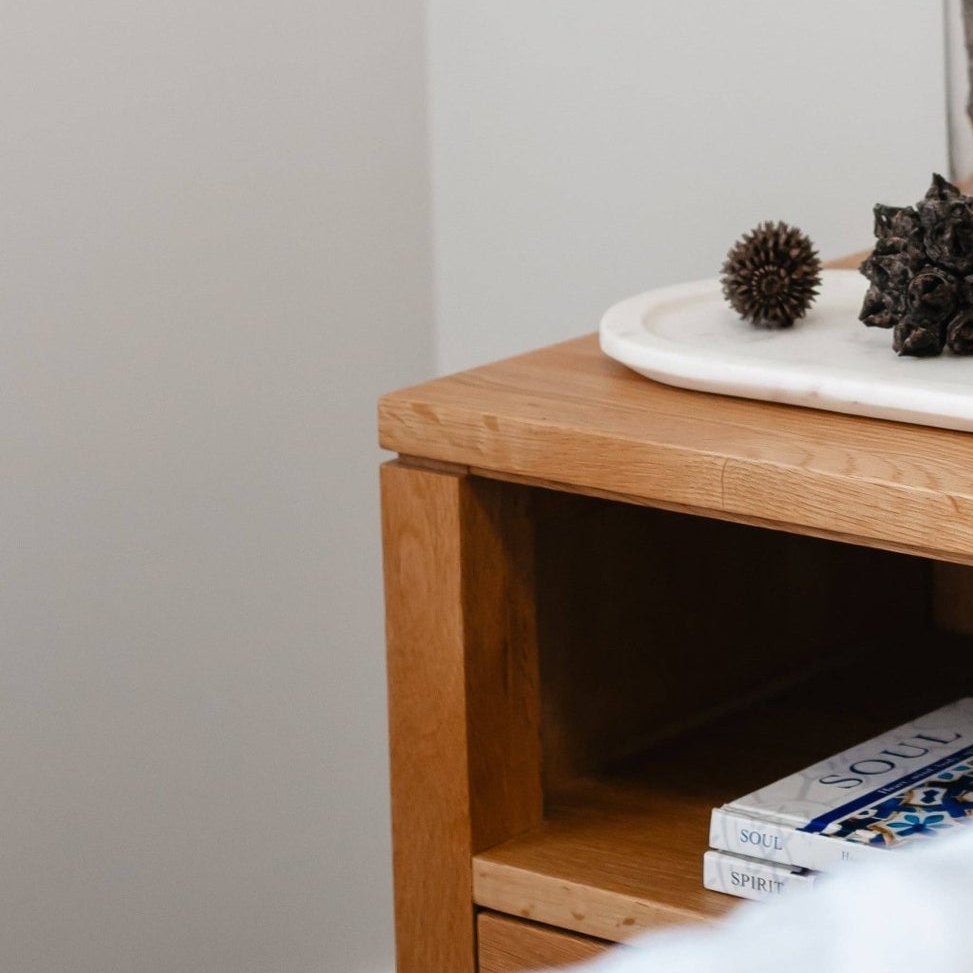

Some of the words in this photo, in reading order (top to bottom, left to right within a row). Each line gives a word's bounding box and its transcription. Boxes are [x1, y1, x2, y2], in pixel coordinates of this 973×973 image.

[818, 732, 962, 790] SOUL
[740, 828, 783, 851] SOUL
[731, 871, 785, 894] SPIRIT
